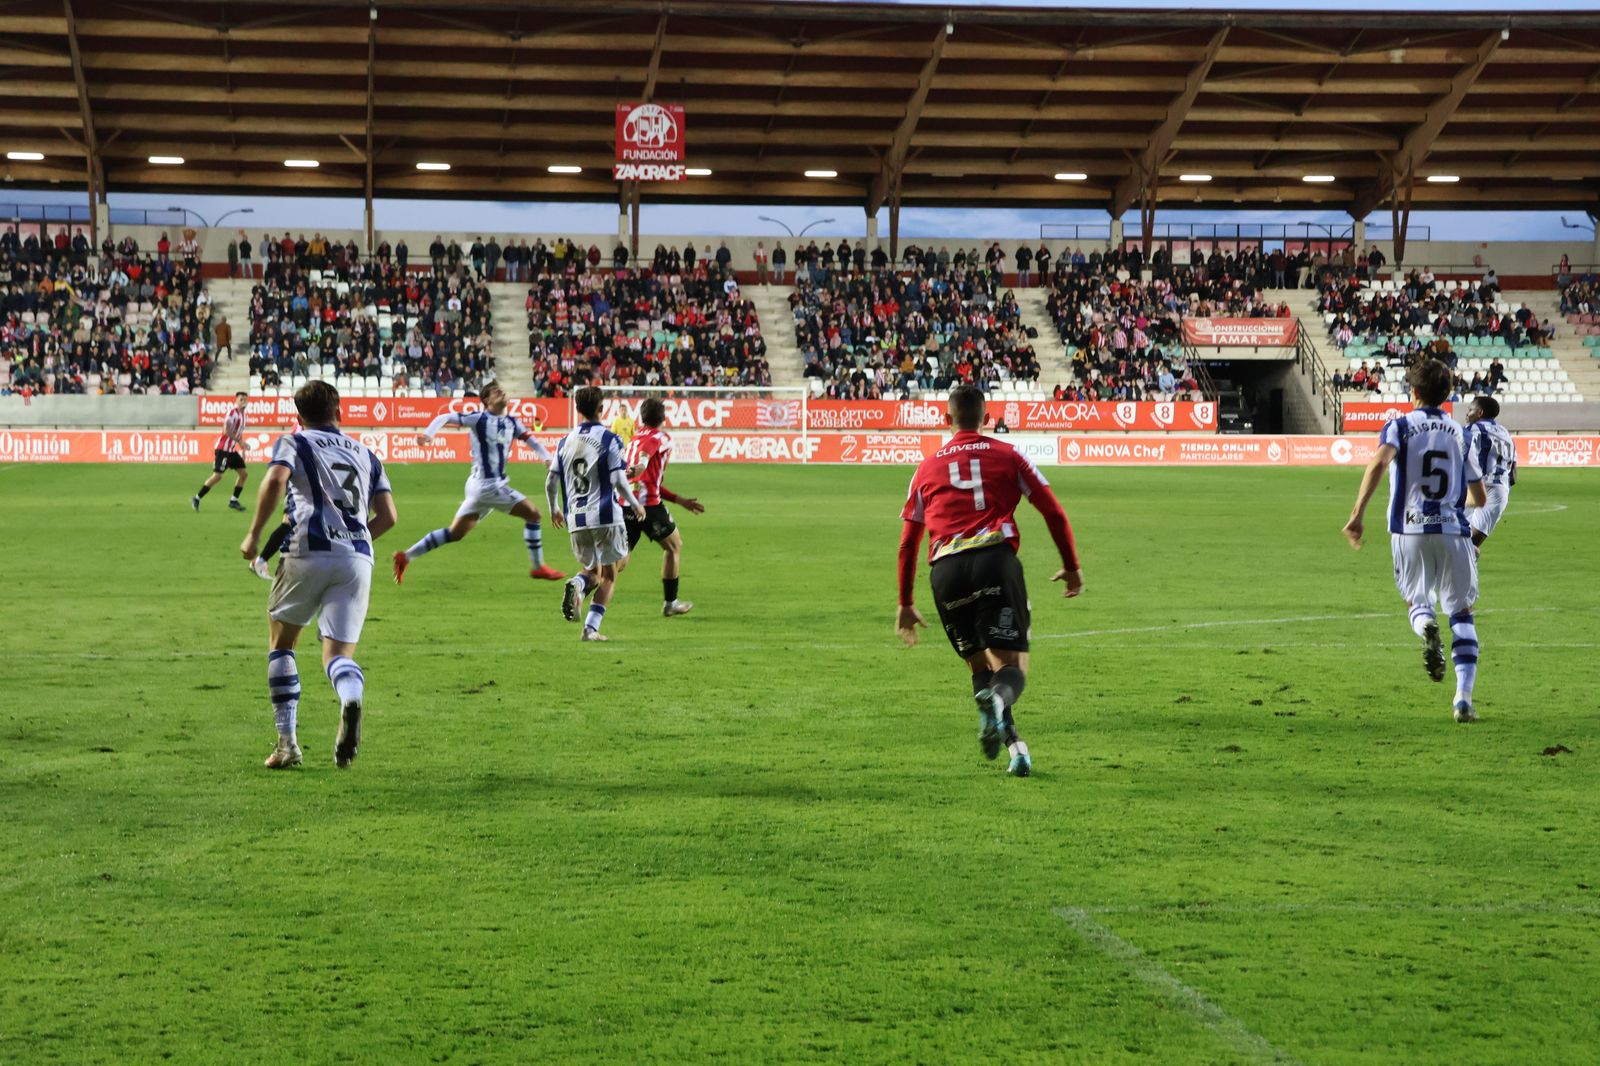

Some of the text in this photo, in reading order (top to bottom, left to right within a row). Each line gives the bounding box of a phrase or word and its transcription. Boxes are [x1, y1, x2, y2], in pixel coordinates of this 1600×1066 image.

[623, 149, 677, 160] FUNDACIÓN
[615, 163, 685, 180] ZAMORACF
[697, 399, 733, 427] CF
[840, 407, 883, 420] ÓPTICO
[903, 402, 939, 418] fisio
[1027, 403, 1100, 420] ZAMORA
[810, 418, 863, 428] ROBERTO
[0, 432, 70, 462] Opinión
[101, 432, 199, 462] La Opinión
[315, 438, 361, 455] BALDA
[935, 441, 990, 458] CLAVERÍA
[1180, 443, 1260, 451] TIENDA ONLINE
[1528, 436, 1592, 451] FUNDACIÓN
[392, 447, 425, 458] Castilla
[424, 449, 432, 461] y
[434, 447, 456, 459] León
[861, 449, 925, 463] ZAMORA
[1085, 445, 1165, 460] INNOVA Chef
[1528, 451, 1592, 465] ZAMORACF
[572, 458, 590, 494] 8
[1421, 450, 1448, 500] 5
[331, 462, 360, 516] 3
[948, 458, 986, 511] 4
